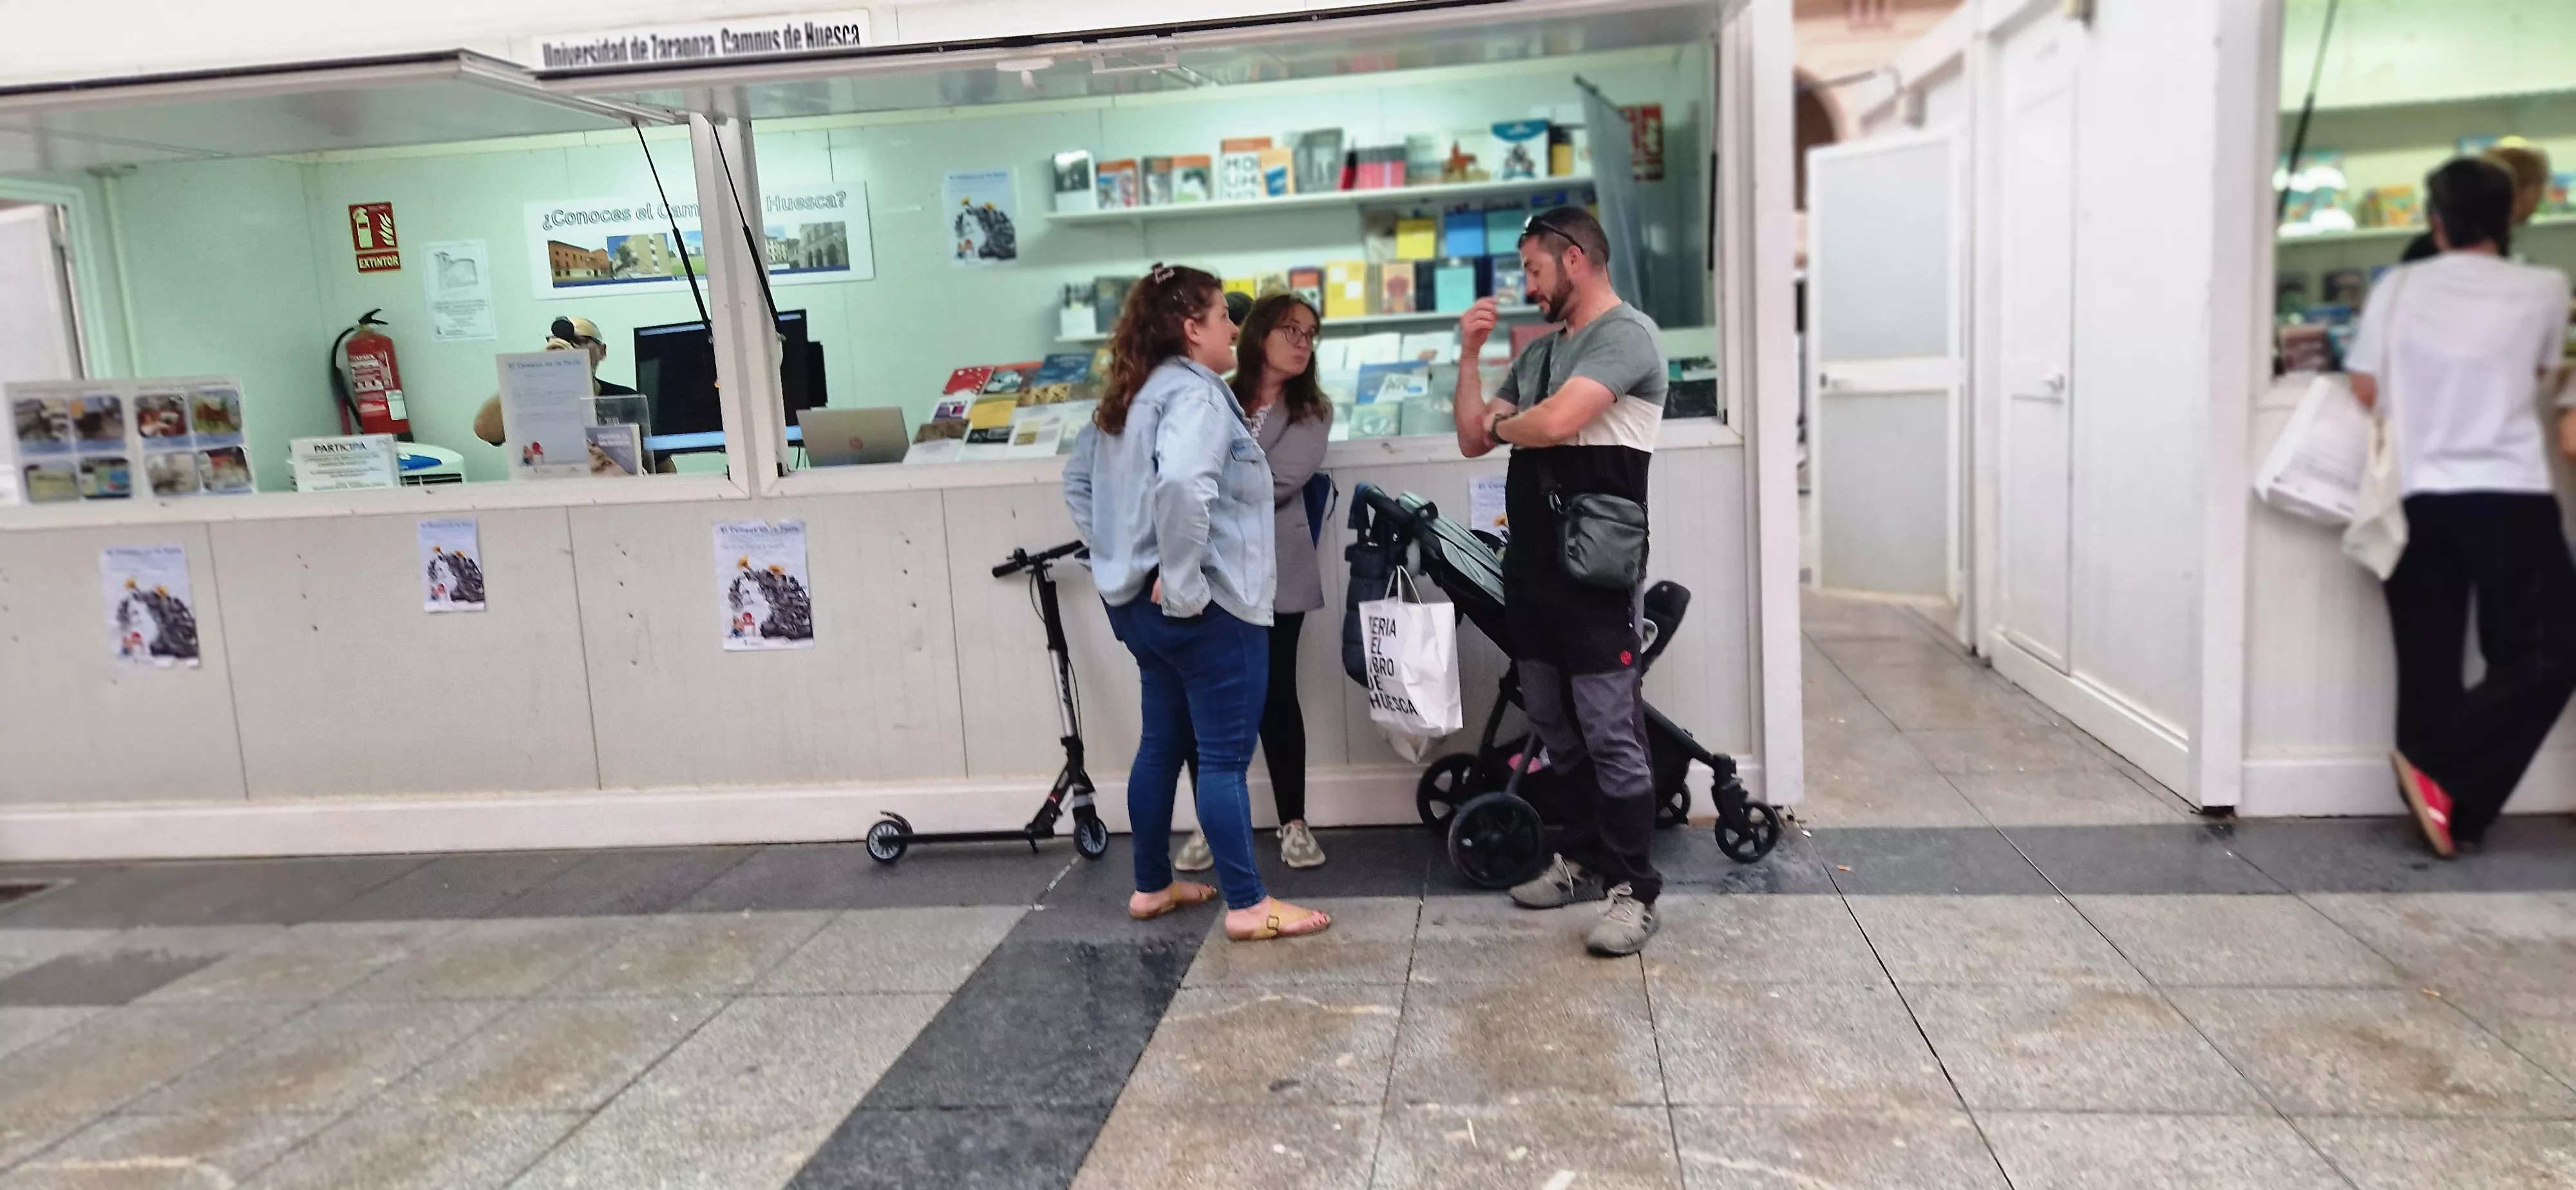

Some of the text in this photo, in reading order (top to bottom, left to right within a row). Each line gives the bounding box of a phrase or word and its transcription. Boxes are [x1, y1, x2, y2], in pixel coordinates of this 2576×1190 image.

[543, 37, 629, 68] Universidad
[630, 35, 648, 62] de
[784, 23, 802, 50] de
[805, 21, 860, 48] Huesca
[542, 190, 847, 231] ¿Conoces el Cam Huesca?
[358, 255, 399, 269] EXTINTOR
[314, 442, 368, 453] PARTICIPA
[1371, 637, 1382, 655] EL
[1369, 657, 1394, 677] BRO
[1370, 692, 1419, 716] HUESCA
